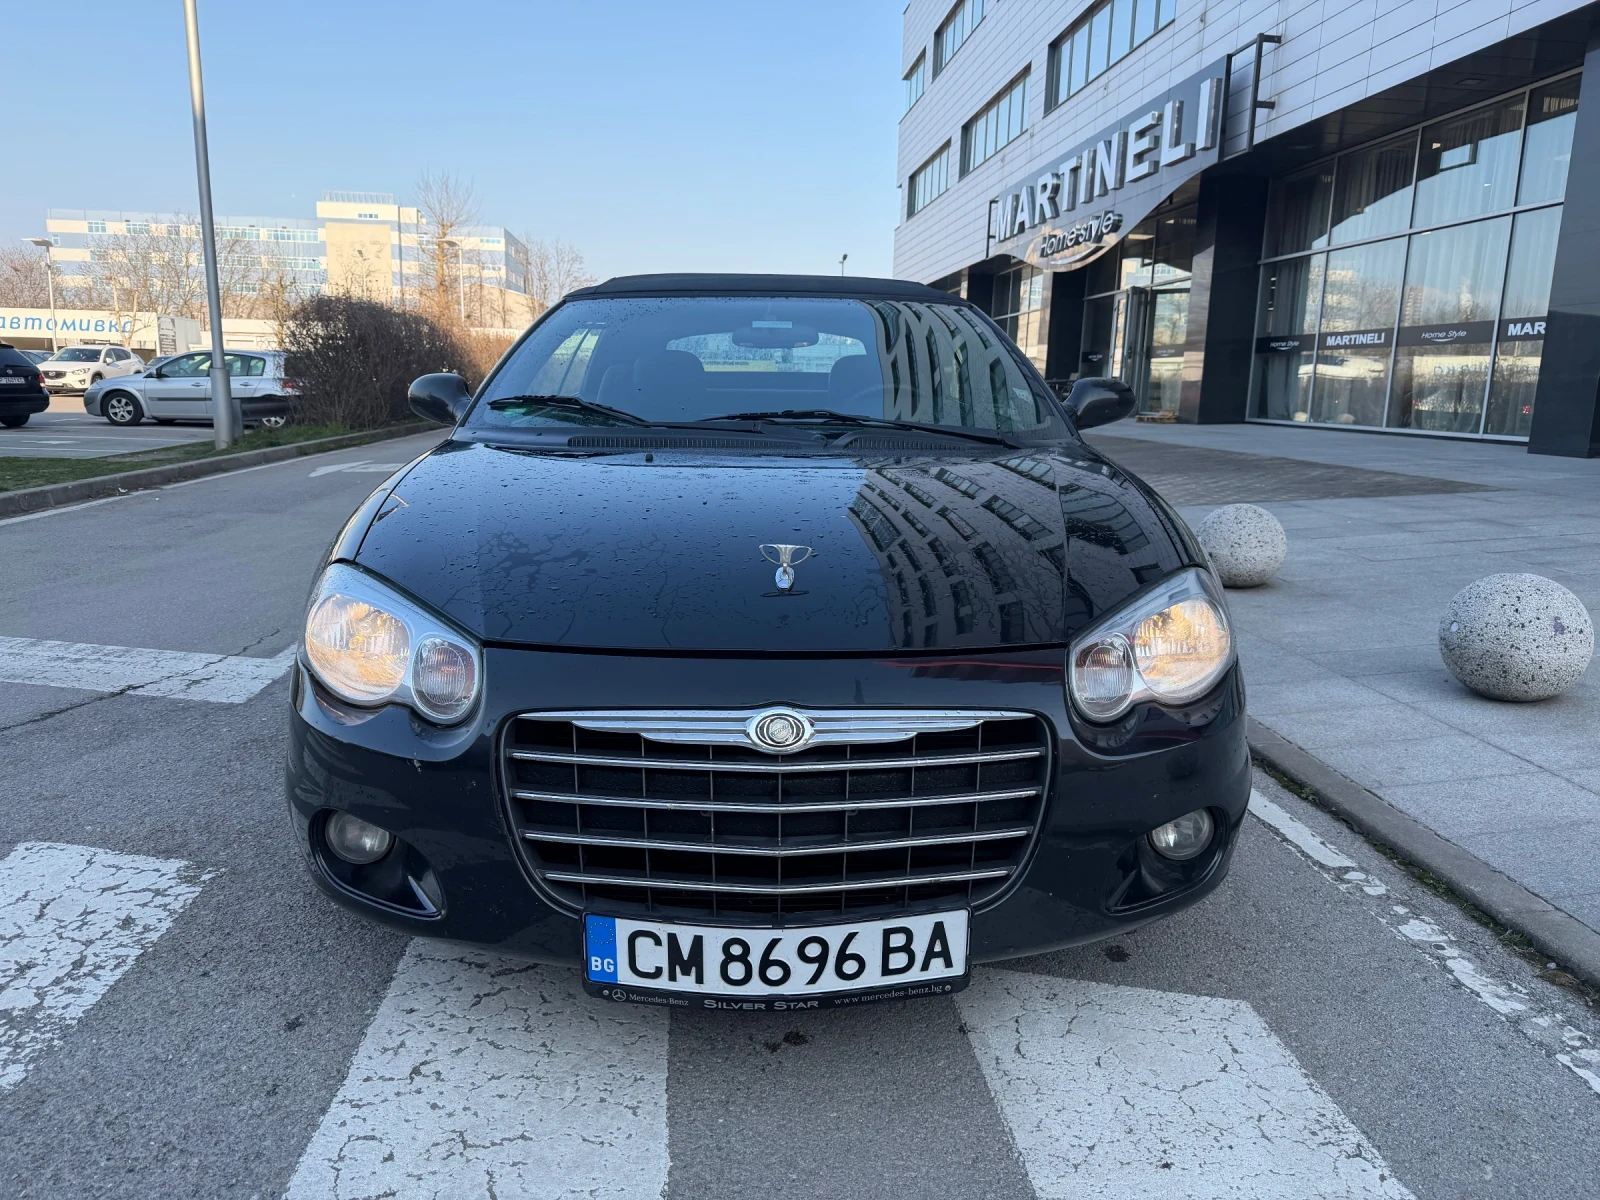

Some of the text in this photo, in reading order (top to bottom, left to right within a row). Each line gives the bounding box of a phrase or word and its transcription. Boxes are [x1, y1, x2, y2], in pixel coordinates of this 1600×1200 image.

[996, 77, 1222, 243] MARTINELI
[1420, 330, 1467, 339] Home Style
[1507, 321, 1547, 336] MAR
[1326, 332, 1386, 347] MARTINELI
[627, 921, 954, 987] CM 8696 BA
[591, 956, 615, 973] BG
[628, 992, 690, 1007] Mercedes-Benz
[834, 984, 943, 1006] www.mercedes-benz.bg
